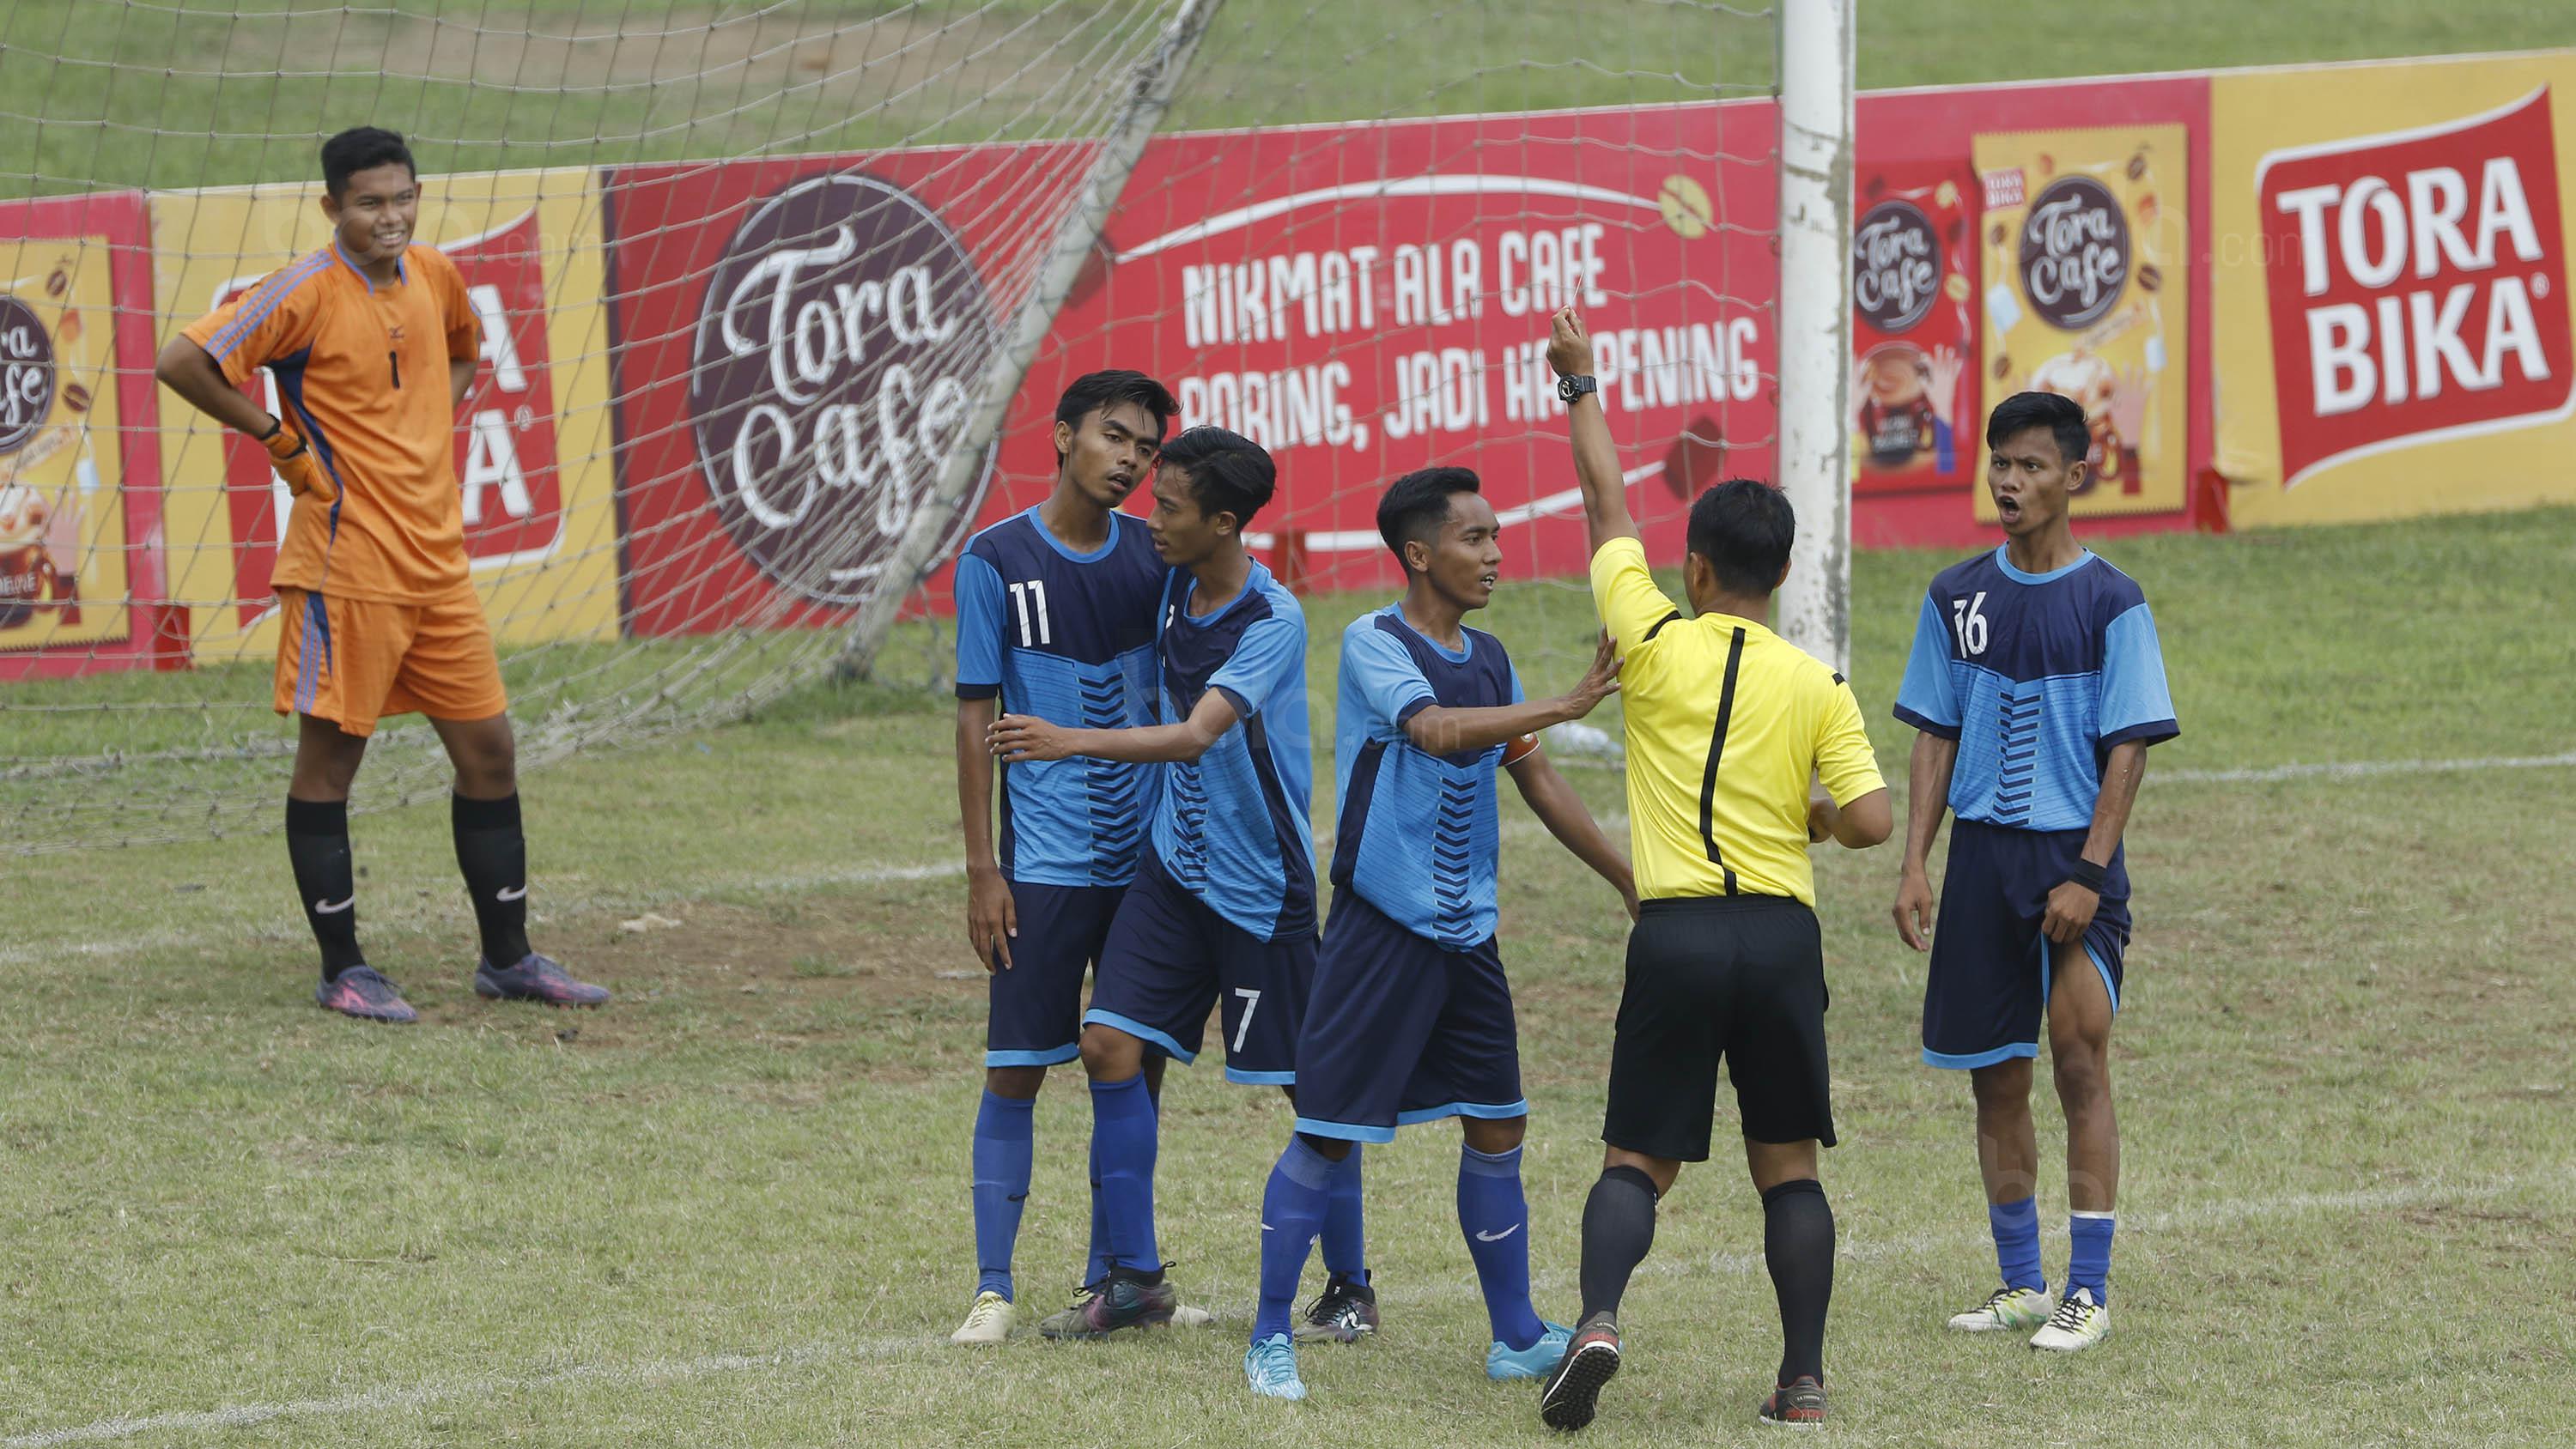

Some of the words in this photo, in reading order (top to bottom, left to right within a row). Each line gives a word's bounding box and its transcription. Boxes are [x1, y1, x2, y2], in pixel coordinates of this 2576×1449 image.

[1855, 215, 1929, 271] Tora
[2029, 193, 2116, 258] Tora
[2275, 156, 2544, 296] TORA
[1182, 246, 1378, 348] NIKMAT
[1394, 239, 1483, 326] ALA
[1498, 223, 1608, 317] CAFE
[1856, 258, 1937, 313] Cafe
[2031, 243, 2124, 307] Cafe
[722, 224, 957, 404] Tora
[389, 350, 400, 390] 1
[1383, 347, 1489, 440] JADI
[1504, 317, 1759, 421] HAPENING
[733, 364, 968, 537] Cafe
[1009, 580, 1051, 648] 11
[1953, 591, 1988, 658] 16
[1233, 987, 1261, 1053] 7
